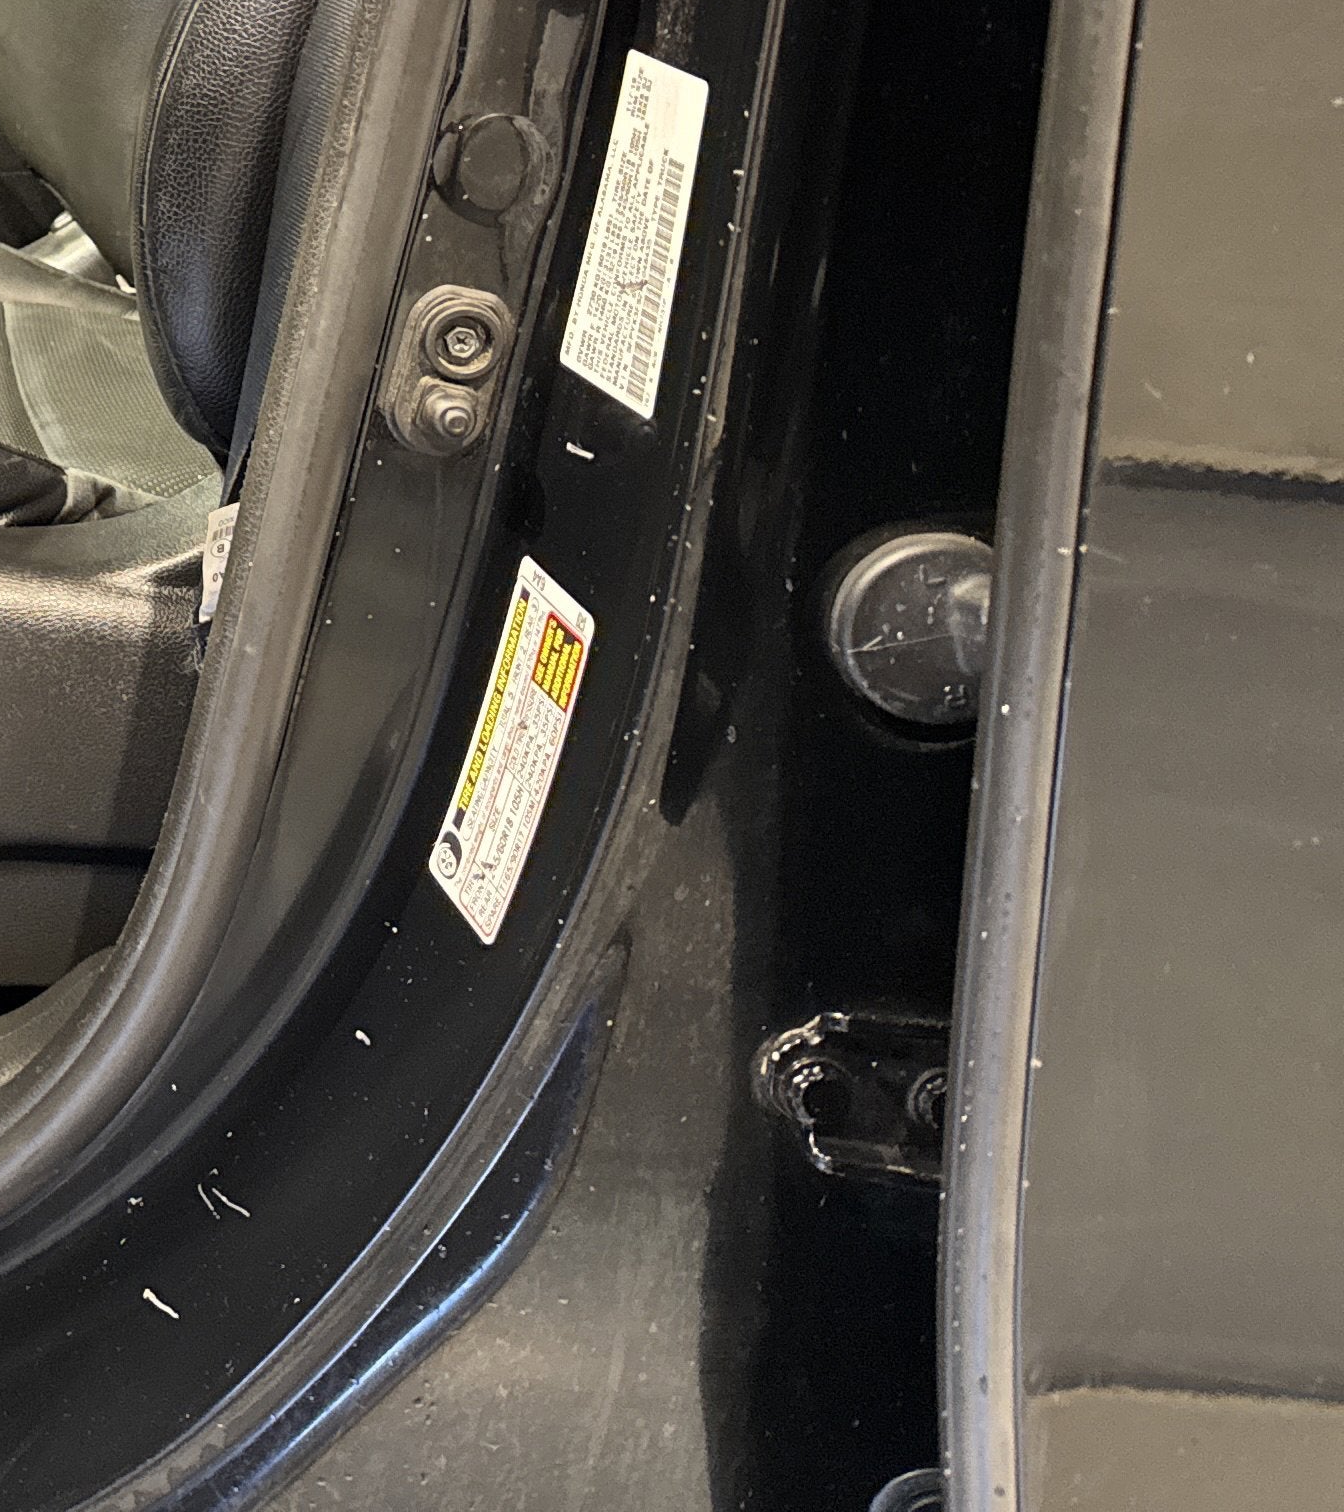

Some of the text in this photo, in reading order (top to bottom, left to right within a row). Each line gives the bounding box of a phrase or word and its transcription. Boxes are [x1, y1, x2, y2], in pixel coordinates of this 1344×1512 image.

[575, 266, 589, 308] HONDA
[629, 254, 643, 300] SWN
[599, 299, 613, 347] VEHICLE
[532, 659, 546, 686] SEE
[541, 624, 565, 694] MANUAL FOR
[549, 637, 572, 702] ADDITIONAL
[557, 637, 582, 711] INFORMATION
[458, 595, 528, 814] TIRE AND LOADING INFORMATION
[487, 803, 501, 834] SIZE
[508, 781, 525, 819] 105H
[468, 878, 485, 915] FRON
